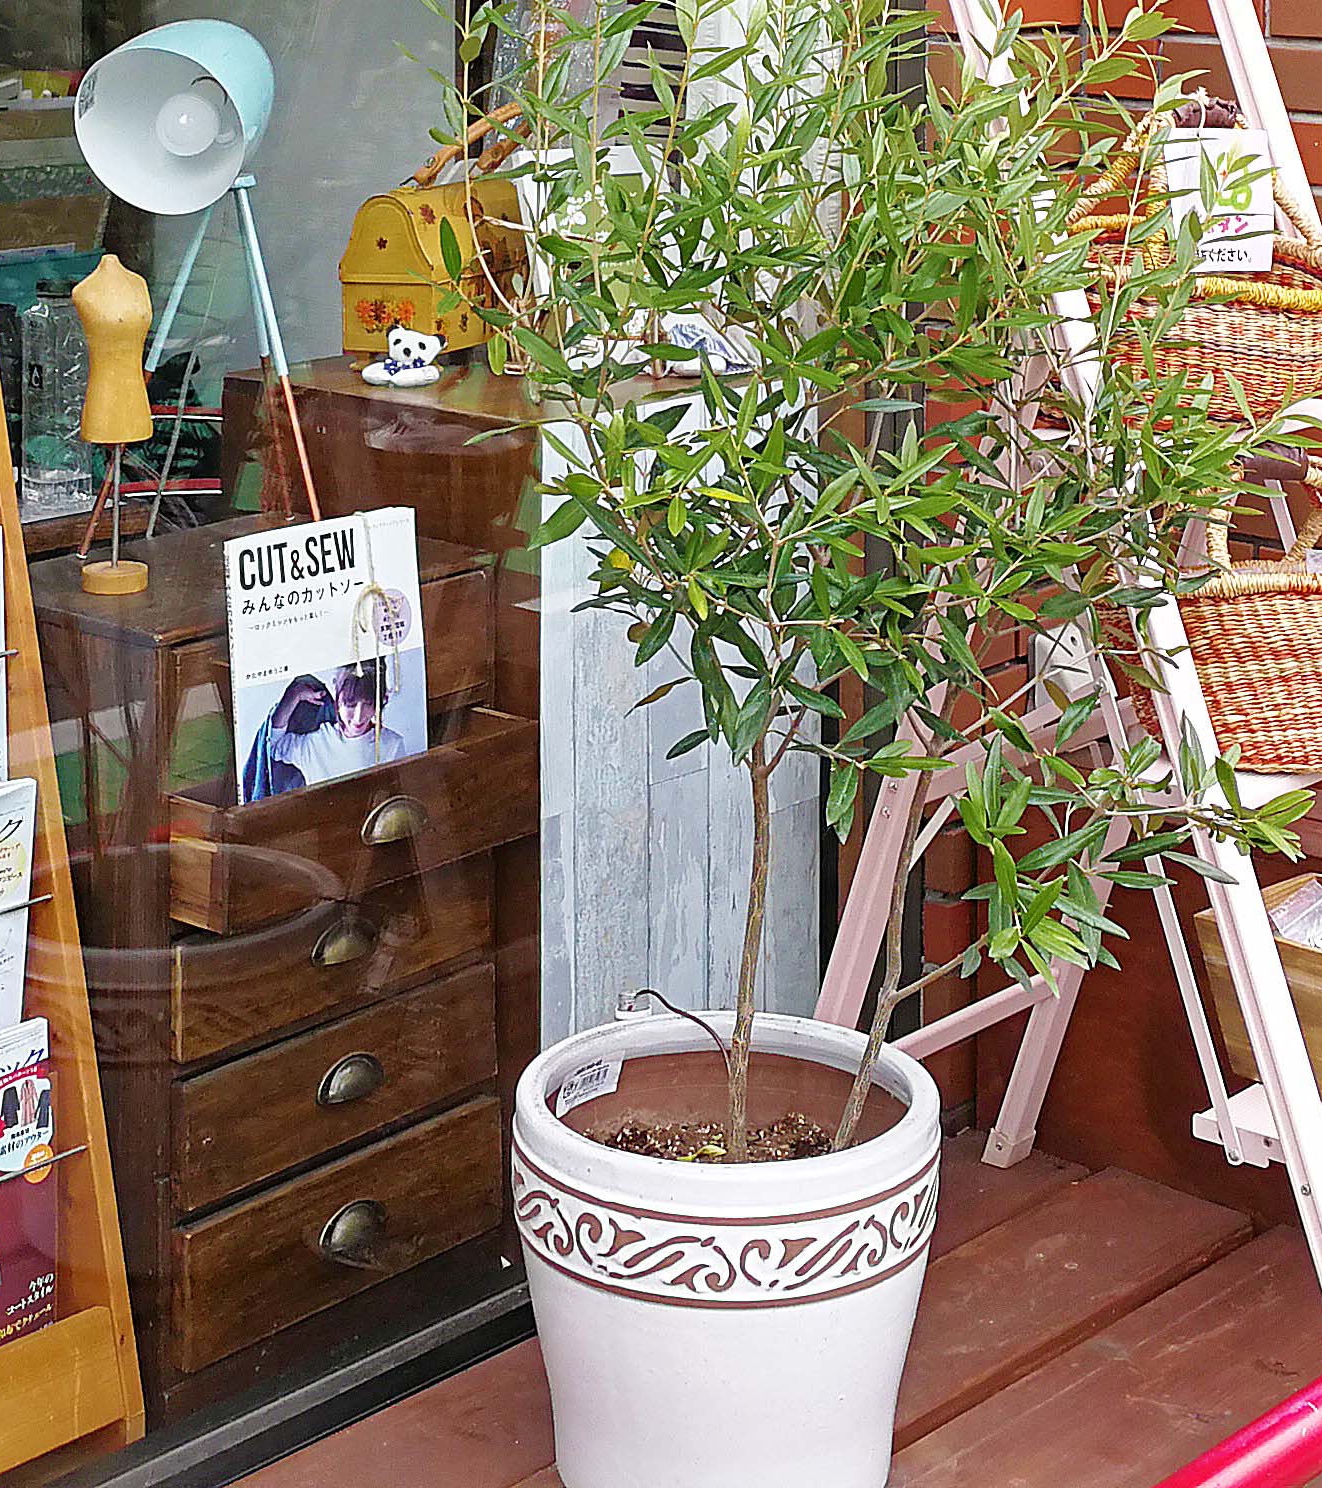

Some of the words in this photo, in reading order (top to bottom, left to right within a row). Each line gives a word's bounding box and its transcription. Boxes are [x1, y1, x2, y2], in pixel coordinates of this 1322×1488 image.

[238, 527, 357, 591] CUT&SEW
[241, 578, 365, 615] みんなのカットソー
